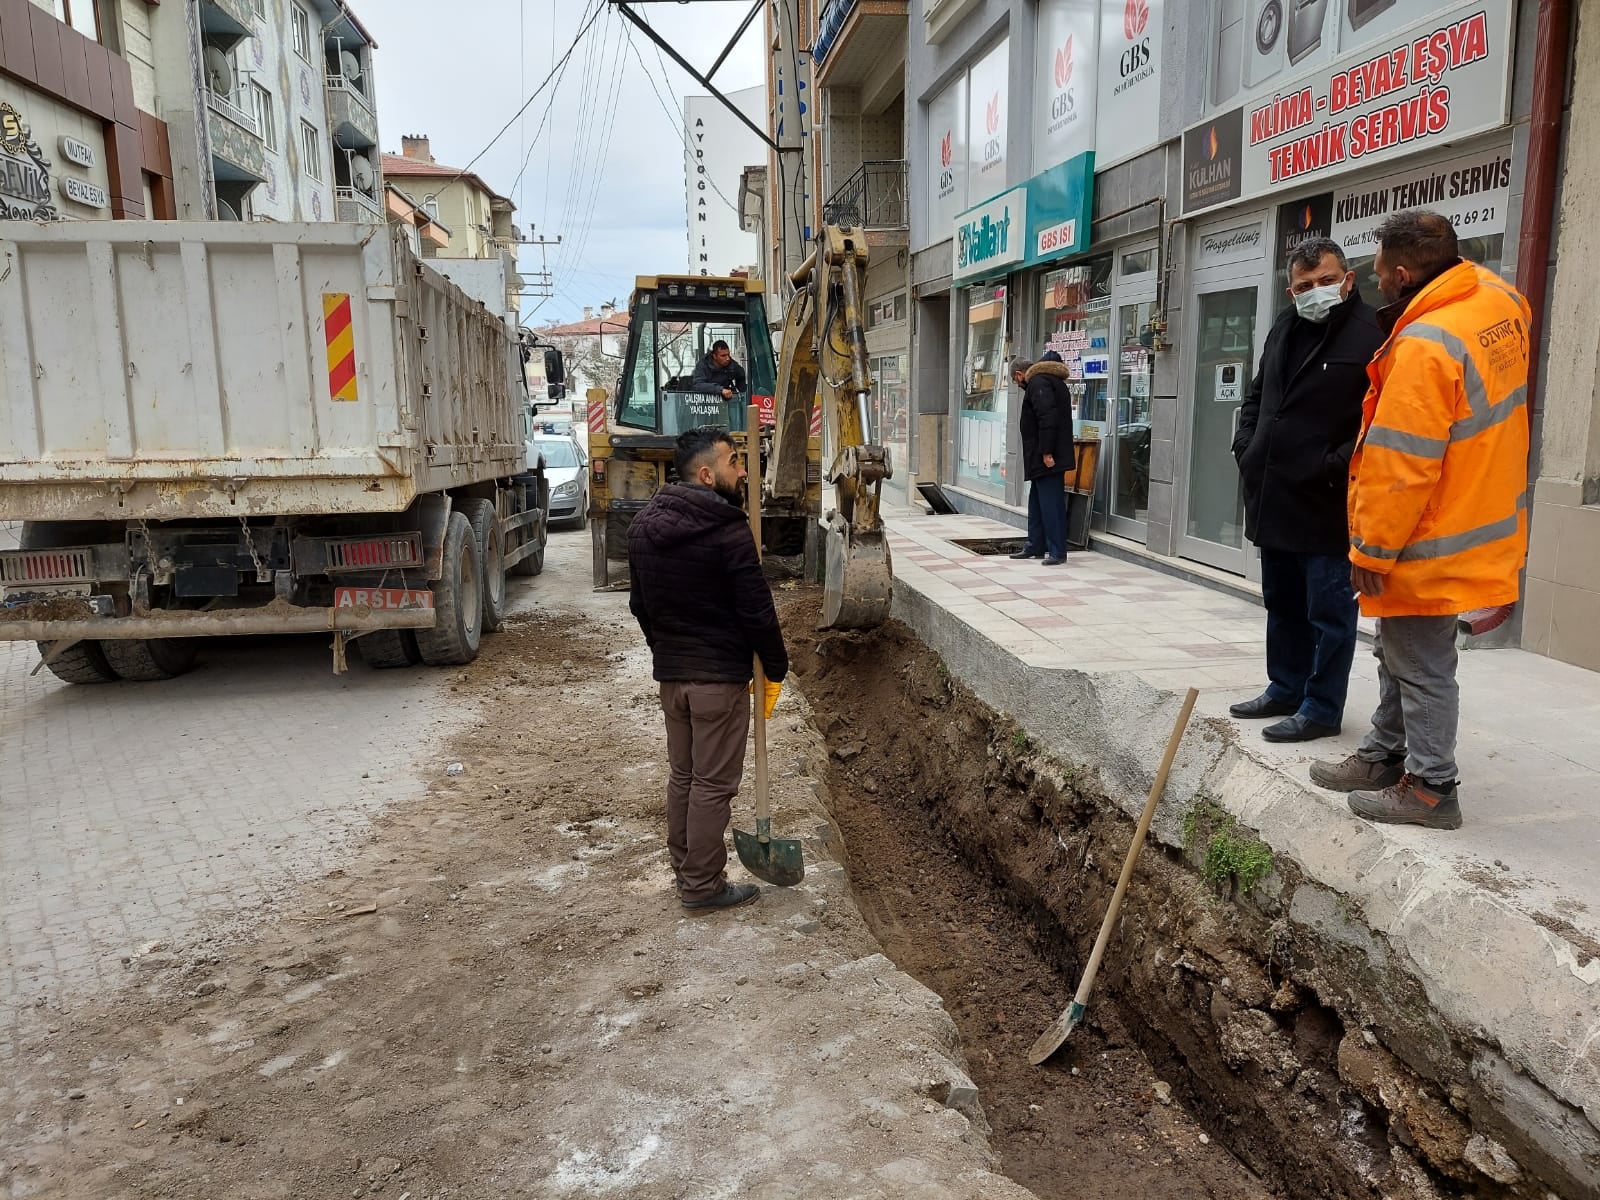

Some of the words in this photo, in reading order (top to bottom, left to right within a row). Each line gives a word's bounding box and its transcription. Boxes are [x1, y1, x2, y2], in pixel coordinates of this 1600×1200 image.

[1120, 37, 1150, 77] GBS
[1250, 87, 1314, 147] KLİMA
[1329, 44, 1409, 116] BEYAZ
[1411, 10, 1488, 85] EŞYA
[1052, 87, 1074, 120] GBS
[1269, 121, 1348, 184] TEKNİK
[1349, 86, 1450, 158] SERVİS
[984, 136, 1000, 161] GBS
[696, 118, 706, 221] AYDOĞAN
[940, 168, 953, 190] GBS
[1188, 158, 1231, 191] KÜLHAN
[68, 181, 88, 201] BEYAZ
[1336, 188, 1389, 223] KÜLHAN
[1392, 173, 1447, 211] TEKNİK
[1449, 156, 1511, 199] SERVİS
[1464, 211, 1478, 225] 69
[1482, 207, 1495, 222] 21
[1041, 229, 1057, 251] GBS
[1205, 230, 1261, 254] Hoşgeldiniz
[689, 406, 720, 417] YAKLAŞMA
[338, 590, 430, 609] ARSLAN
